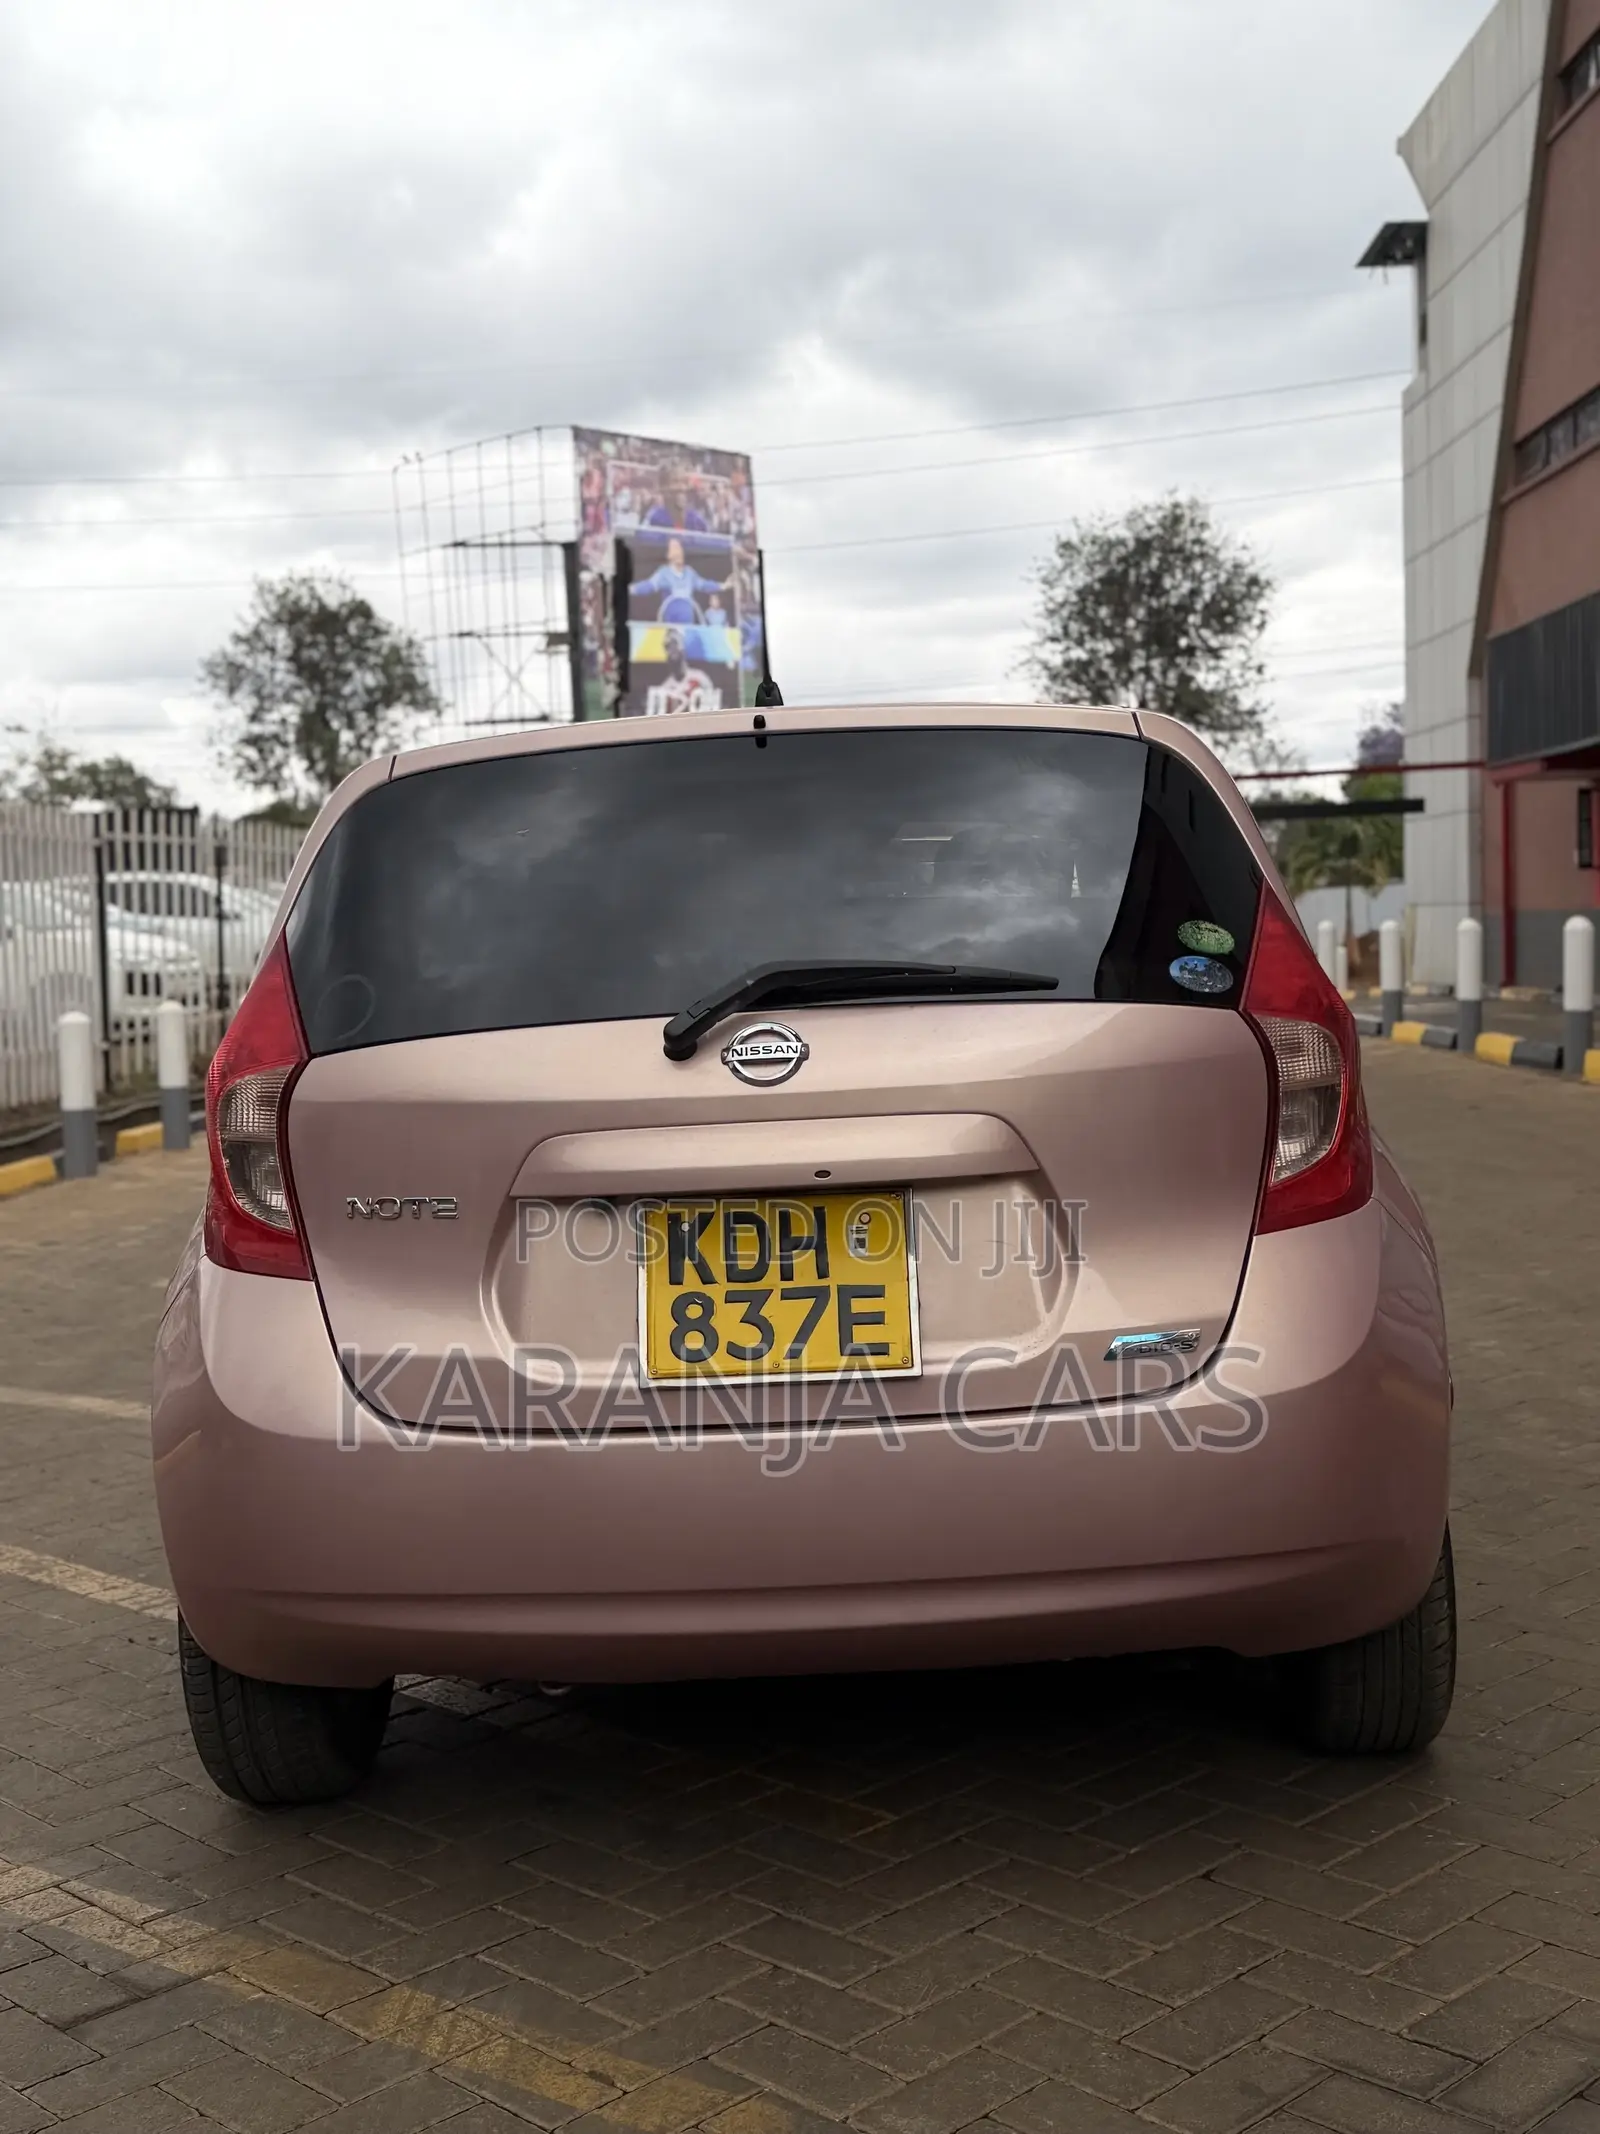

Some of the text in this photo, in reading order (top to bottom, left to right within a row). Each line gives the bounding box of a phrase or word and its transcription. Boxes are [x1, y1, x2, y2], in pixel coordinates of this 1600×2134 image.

[731, 1044, 799, 1058] NISSAN
[346, 1197, 459, 1220] NOTE
[667, 1206, 830, 1286] KDH
[669, 1284, 891, 1364] 837E
